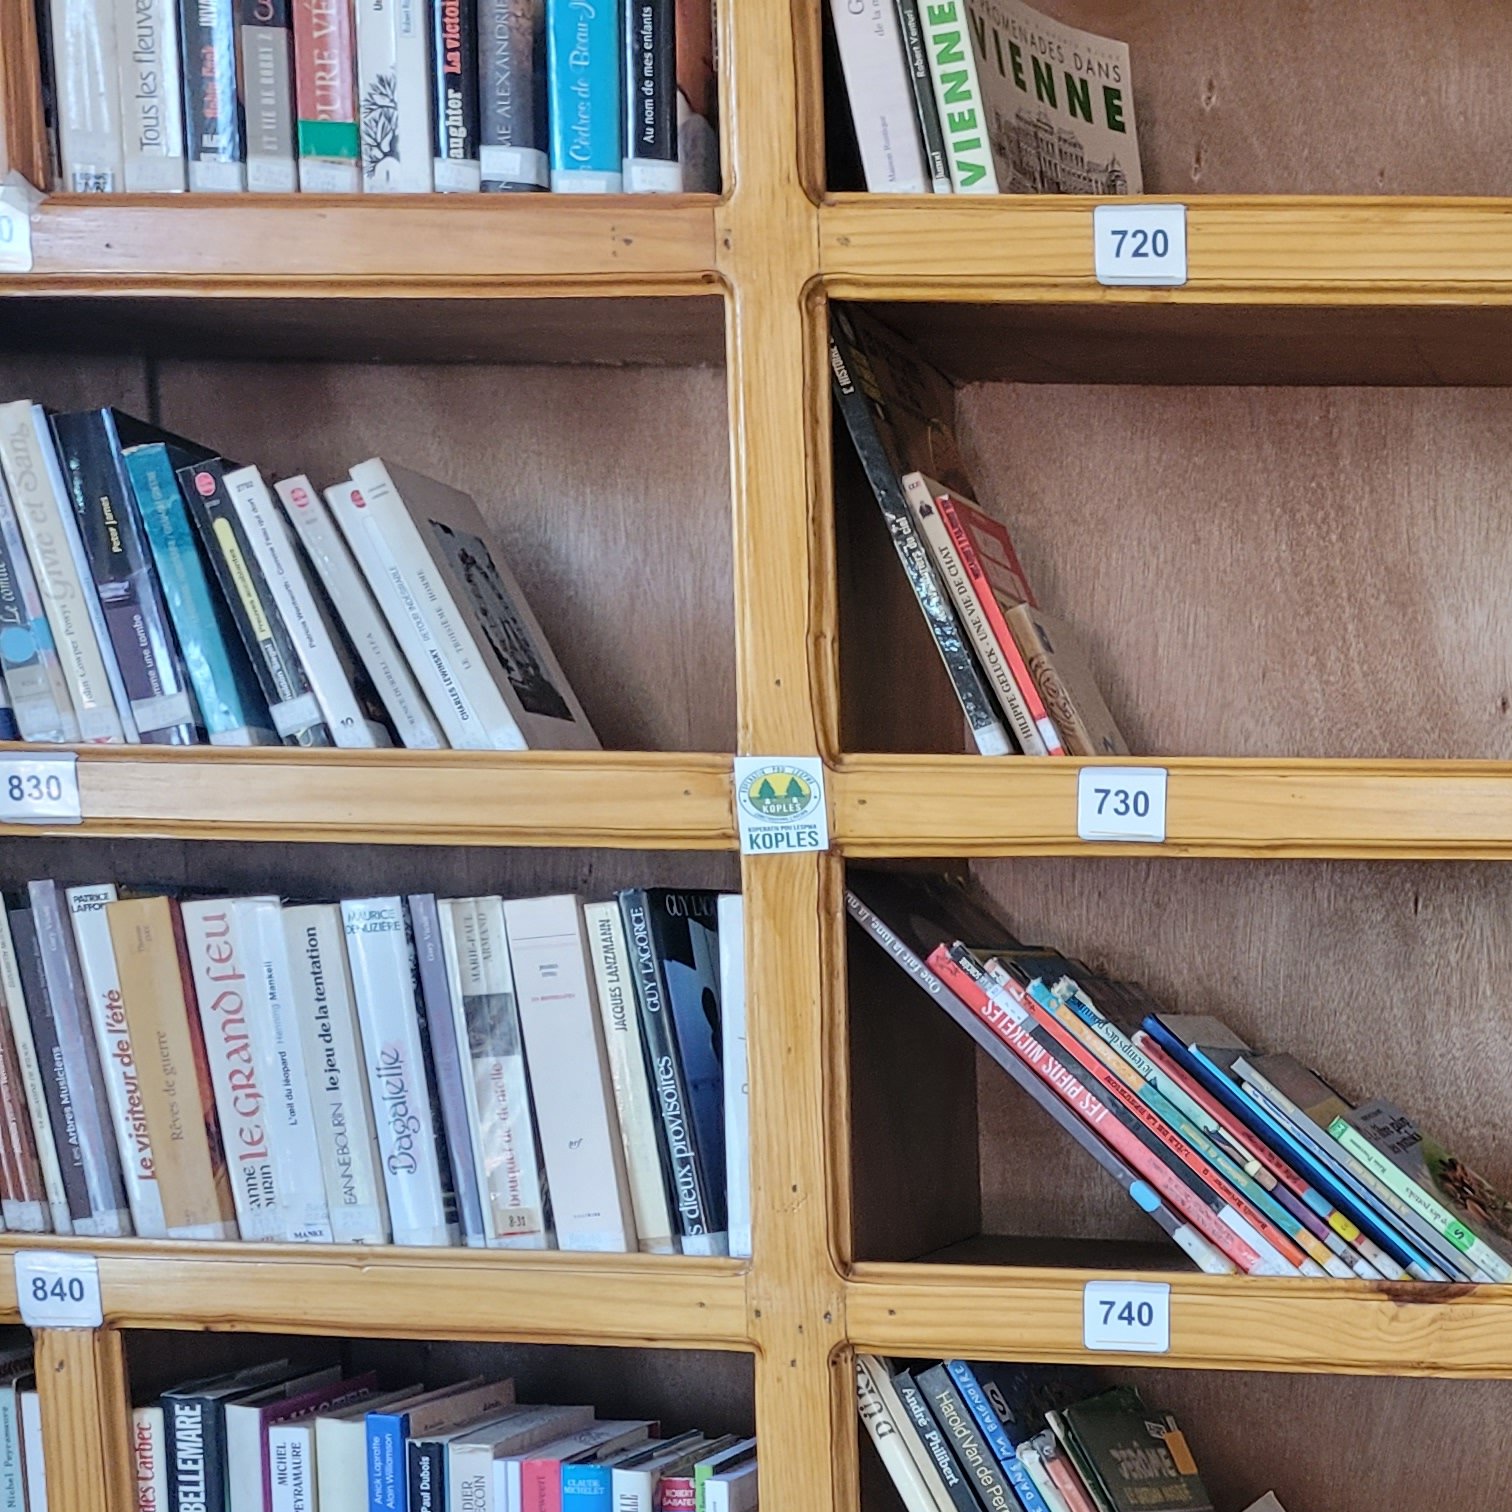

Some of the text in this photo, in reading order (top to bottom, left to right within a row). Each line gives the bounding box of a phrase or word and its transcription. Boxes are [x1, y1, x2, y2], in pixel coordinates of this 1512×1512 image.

[638, 5, 657, 144] Au nom de mes enfants
[909, 46, 926, 79] Robert
[926, 1, 987, 188] VIENNE
[969, 6, 1127, 135] VIENNE
[1072, 51, 1123, 84] DANS
[136, 71, 161, 151] Tous les
[1110, 229, 1169, 258] 720
[100, 494, 124, 553] Peter James
[938, 545, 963, 580] CHAT
[429, 647, 470, 722] CHARLES LEWINSKY
[990, 651, 1016, 692] GELUCK
[7, 774, 61, 802] 830
[1094, 788, 1150, 818] 730
[749, 830, 820, 850] KOPLES
[304, 926, 343, 1092] le jeu de la tentation
[598, 918, 629, 1032] JACQUES LANZMANN
[915, 967, 943, 995] Que
[263, 960, 294, 1086] léopard Mankell
[977, 996, 1085, 1100] PIEDS NICKELES
[49, 1045, 80, 1146] Arbres Musiciens
[100, 988, 157, 1181] Le visiteur de l'été
[154, 1029, 186, 1142] Rêves de guerre
[210, 988, 270, 1163] LE GRAND
[629, 906, 701, 1220] dieux provisoires GUY LAGORCE
[374, 1047, 421, 1177] Bagatelle
[32, 1276, 85, 1302] 840
[1099, 1300, 1154, 1327] 740
[952, 1362, 999, 1434] BAIGNOIRE
[133, 1422, 157, 1482] Carbec
[274, 1441, 289, 1487] MICHEL
[382, 1433, 395, 1484] Williamson
[900, 1384, 962, 1488] André Philibert
[934, 1388, 972, 1441] Harold
[960, 1435, 988, 1468] Van
[975, 1463, 998, 1487] de
[3, 1472, 18, 1509] Michel
[418, 1455, 431, 1491] Dubois
